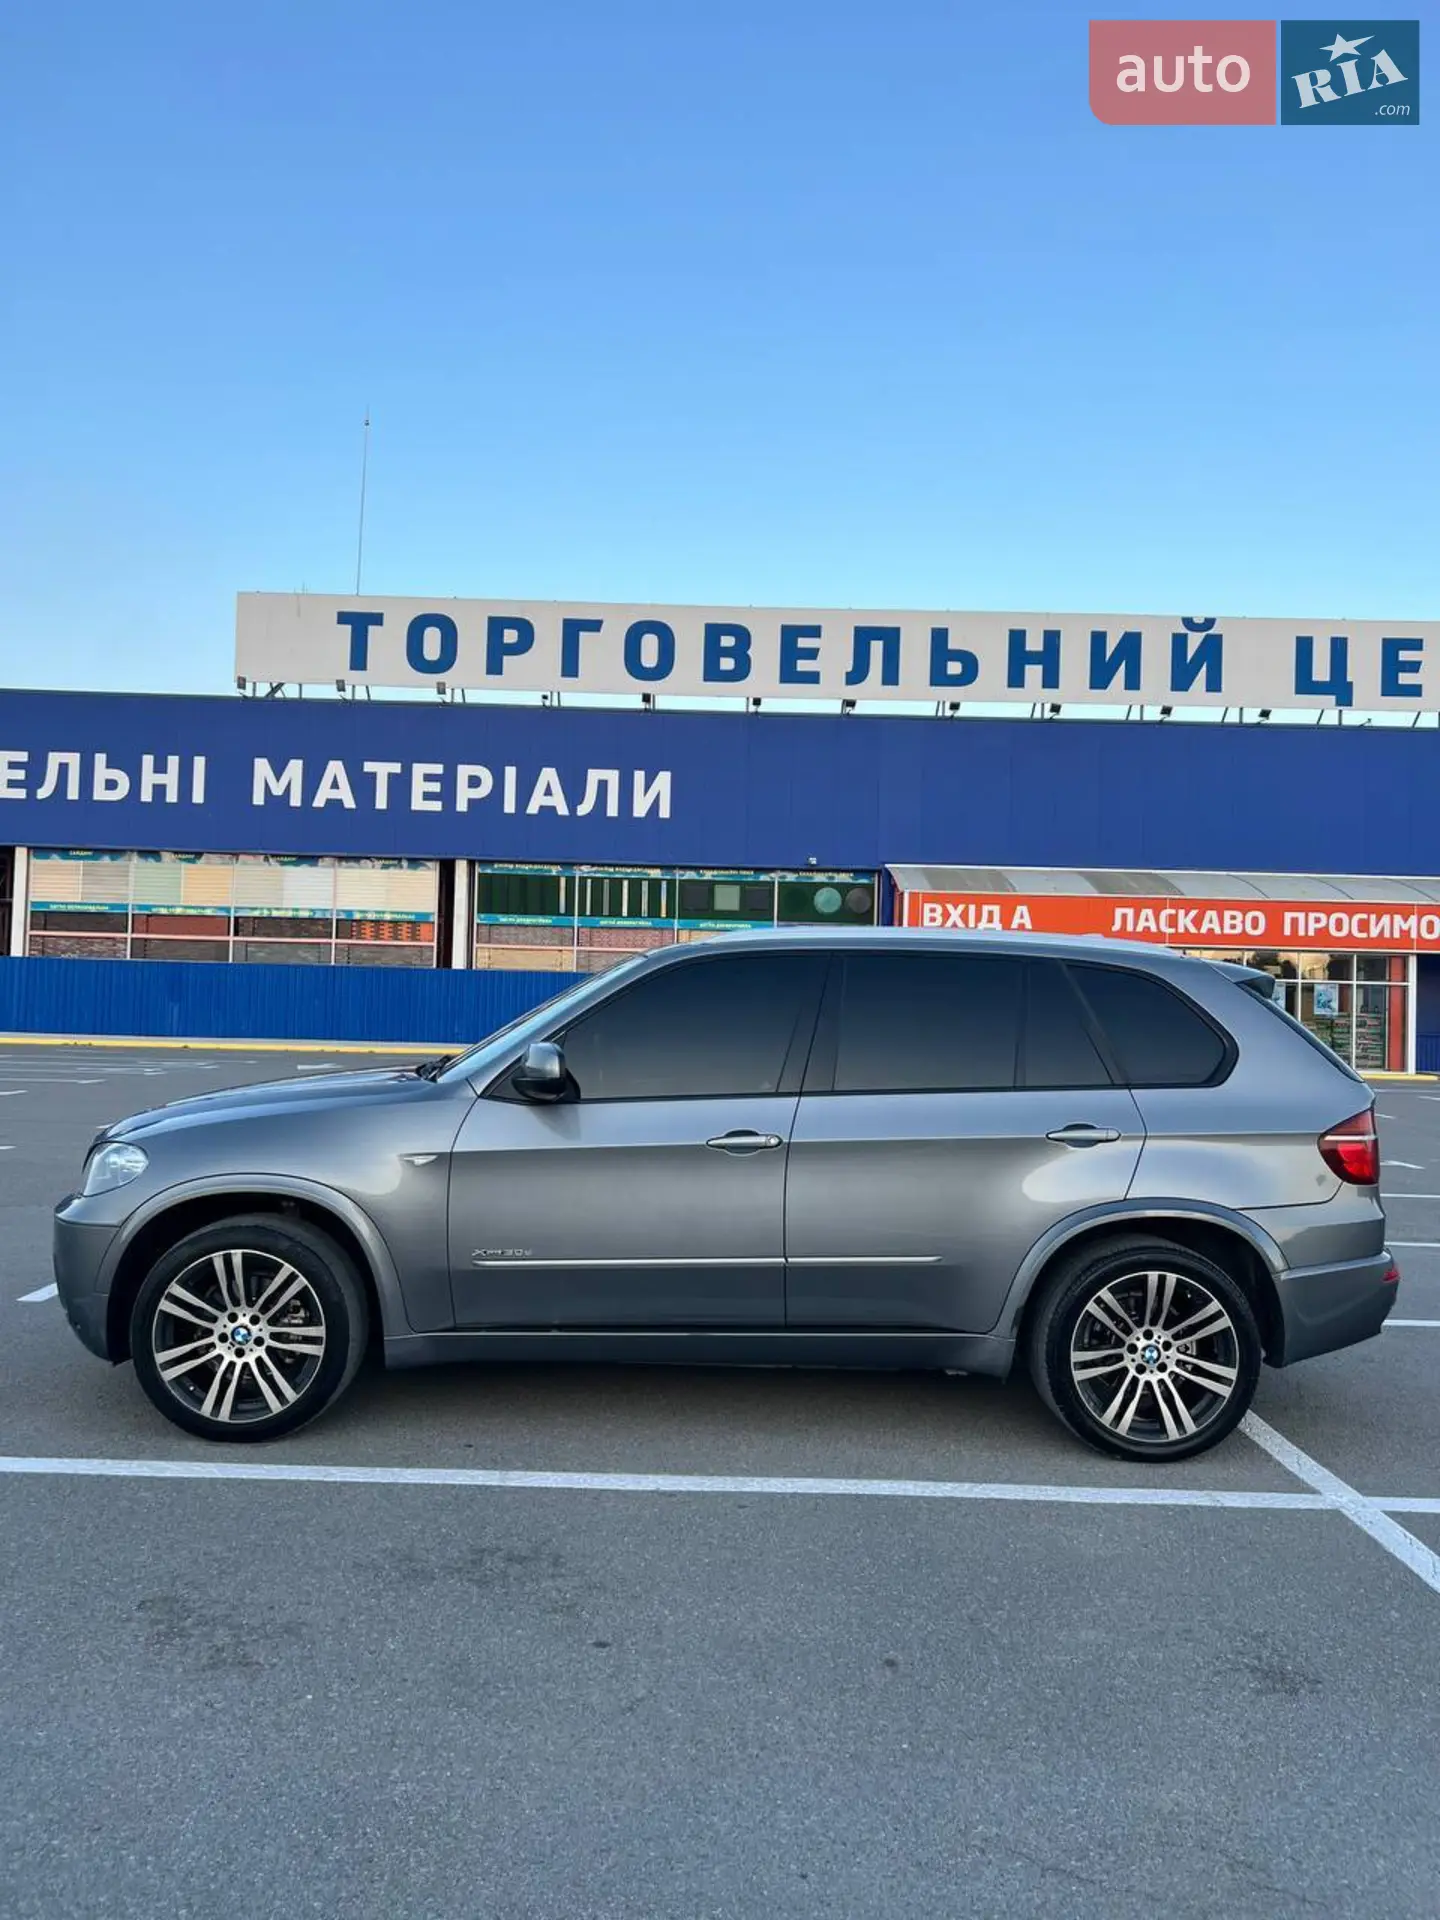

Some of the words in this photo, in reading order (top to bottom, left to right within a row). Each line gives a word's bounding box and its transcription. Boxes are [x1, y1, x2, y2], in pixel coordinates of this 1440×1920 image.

[336, 611, 1223, 693] ТОРГОВЕЛЬНИЙ
[1294, 636, 1424, 708] ЦЕ
[0, 750, 206, 804] ЕЛЬНІ
[252, 757, 672, 819] МАТЕРІАЛИ
[923, 903, 1002, 931] ВХІД
[1010, 905, 1033, 930] А
[1111, 907, 1266, 936] ЛАСКАВО
[1283, 911, 1440, 940] ПРОСИМО
